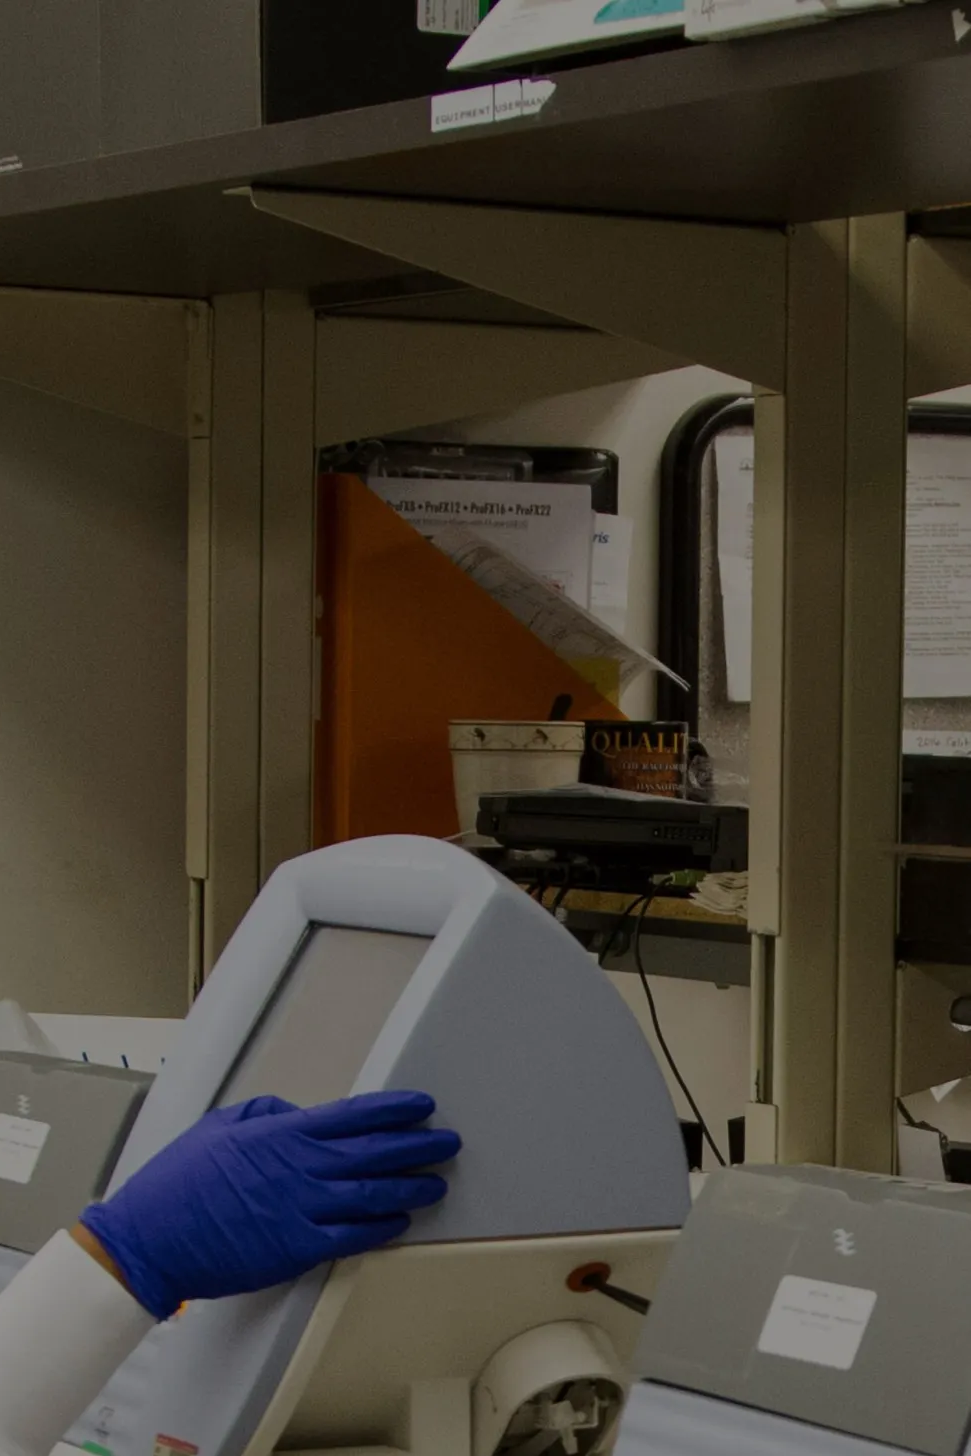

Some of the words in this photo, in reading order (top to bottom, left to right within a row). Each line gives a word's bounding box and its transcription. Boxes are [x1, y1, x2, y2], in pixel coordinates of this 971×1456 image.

[435, 106, 490, 125] EQUIPMENT
[494, 101, 521, 114] USER
[425, 502, 460, 515] ProFX12
[471, 503, 506, 515] ProFX16
[515, 503, 551, 516] ProFX22
